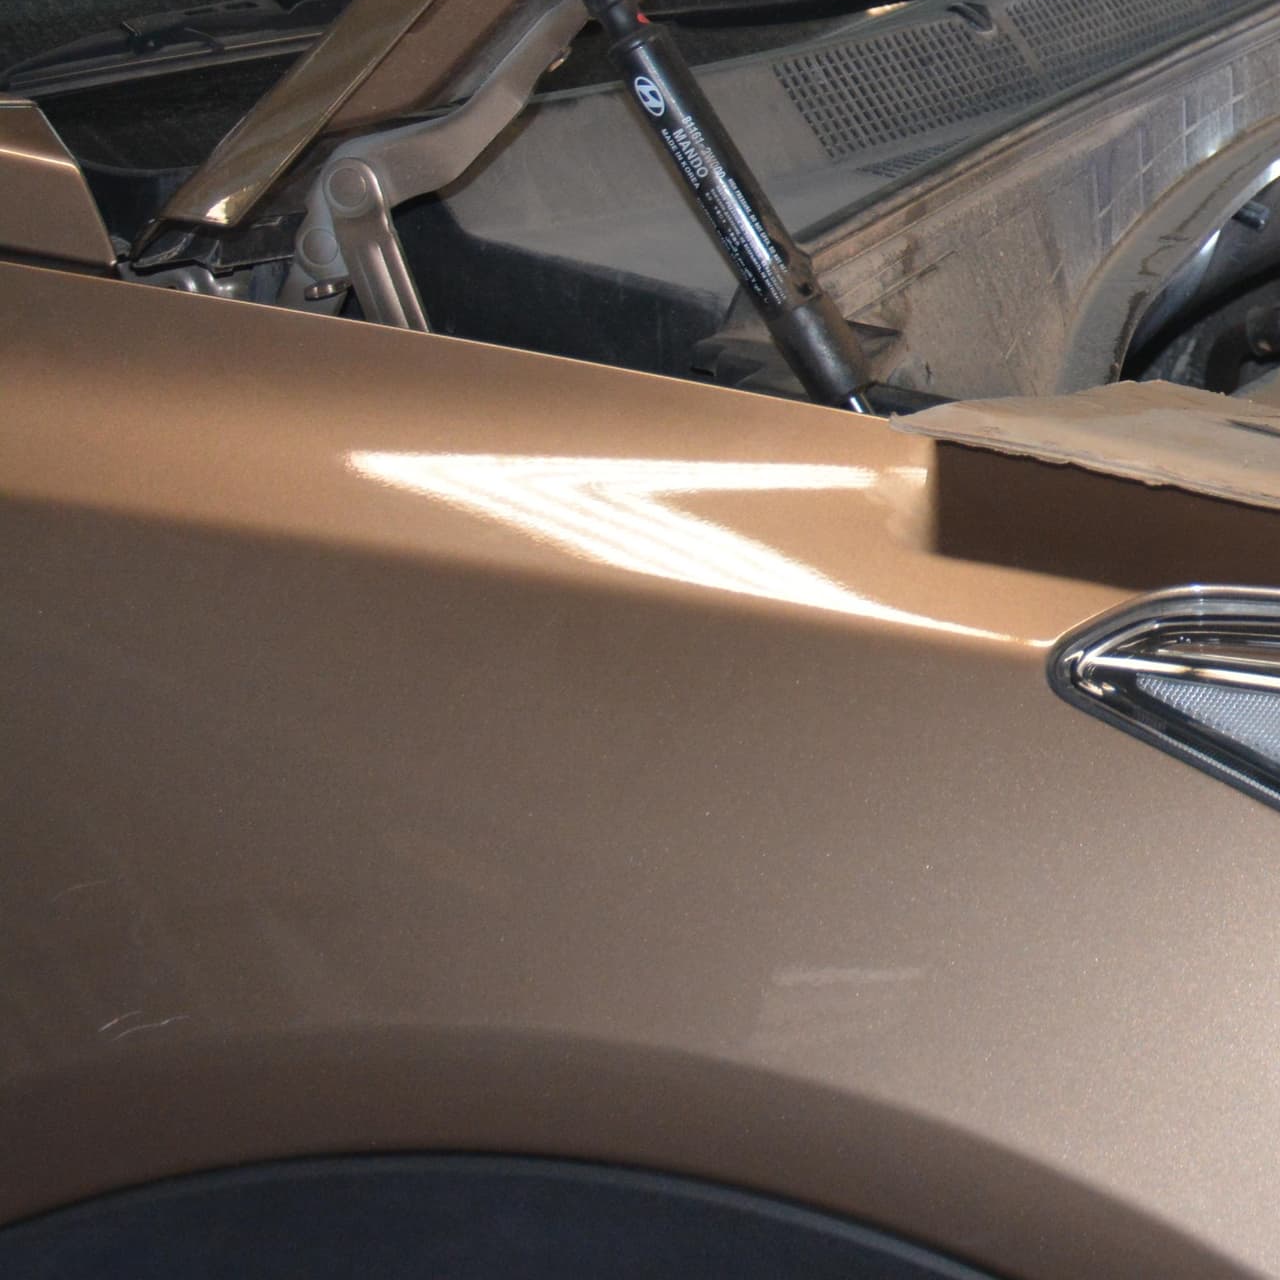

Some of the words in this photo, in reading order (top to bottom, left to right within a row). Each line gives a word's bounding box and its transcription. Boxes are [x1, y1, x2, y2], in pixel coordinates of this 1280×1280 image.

[660, 127, 678, 151] MADE
[674, 150, 684, 160] IN
[679, 159, 701, 189] KOREA
[671, 127, 710, 179] MANDO
